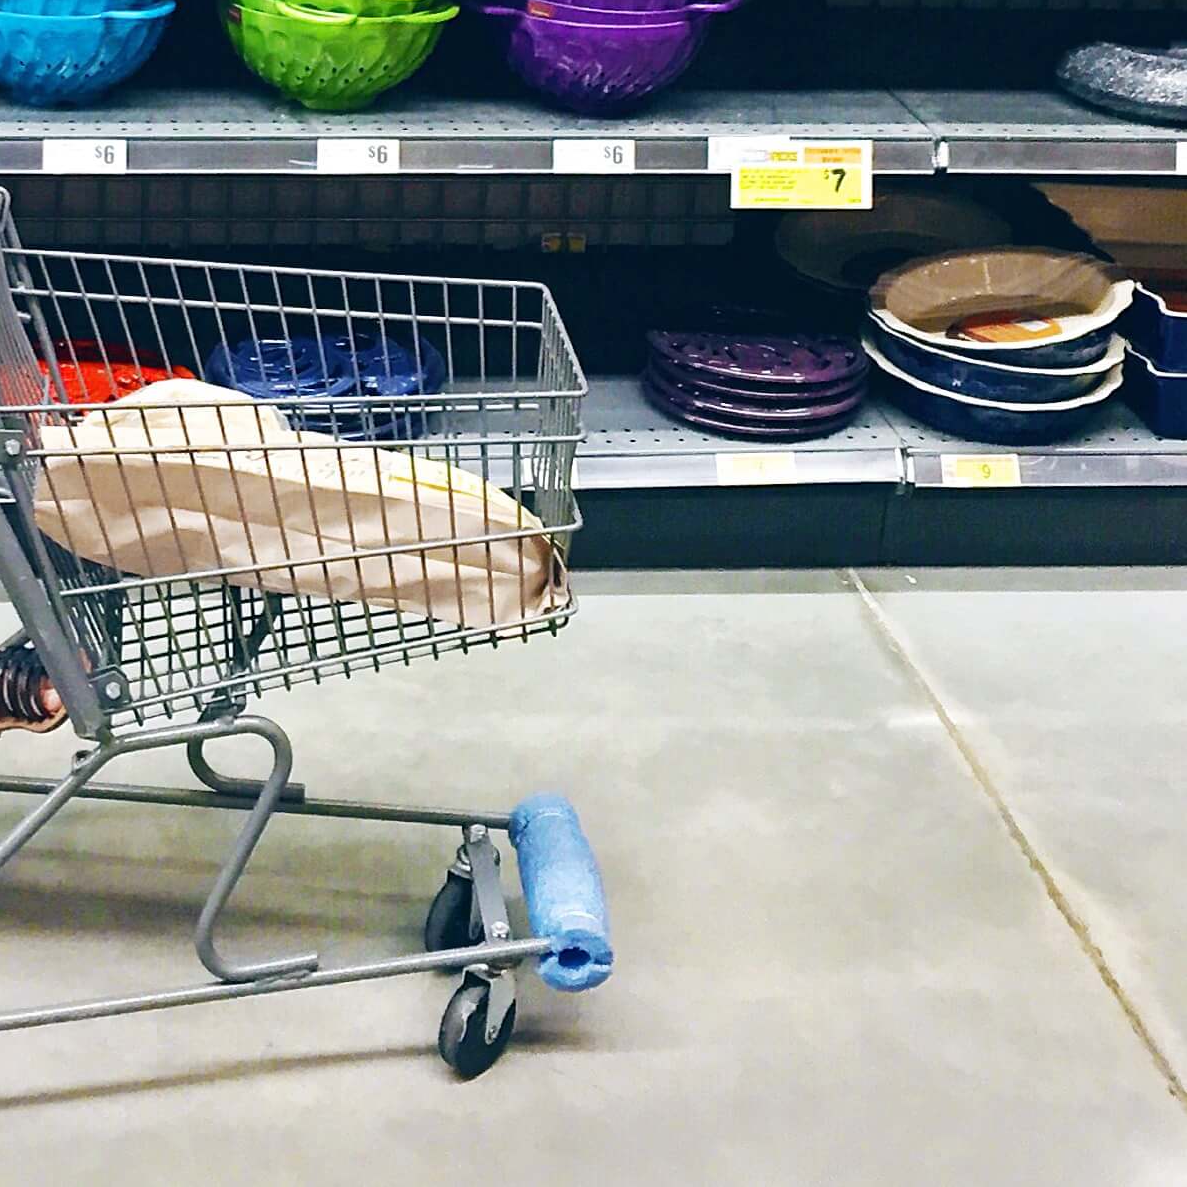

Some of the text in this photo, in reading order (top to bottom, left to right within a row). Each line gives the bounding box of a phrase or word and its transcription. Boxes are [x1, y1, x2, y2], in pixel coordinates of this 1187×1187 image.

[95, 145, 115, 165] $6
[368, 145, 388, 164] $6
[604, 145, 623, 165] $6
[823, 168, 847, 193] $7
